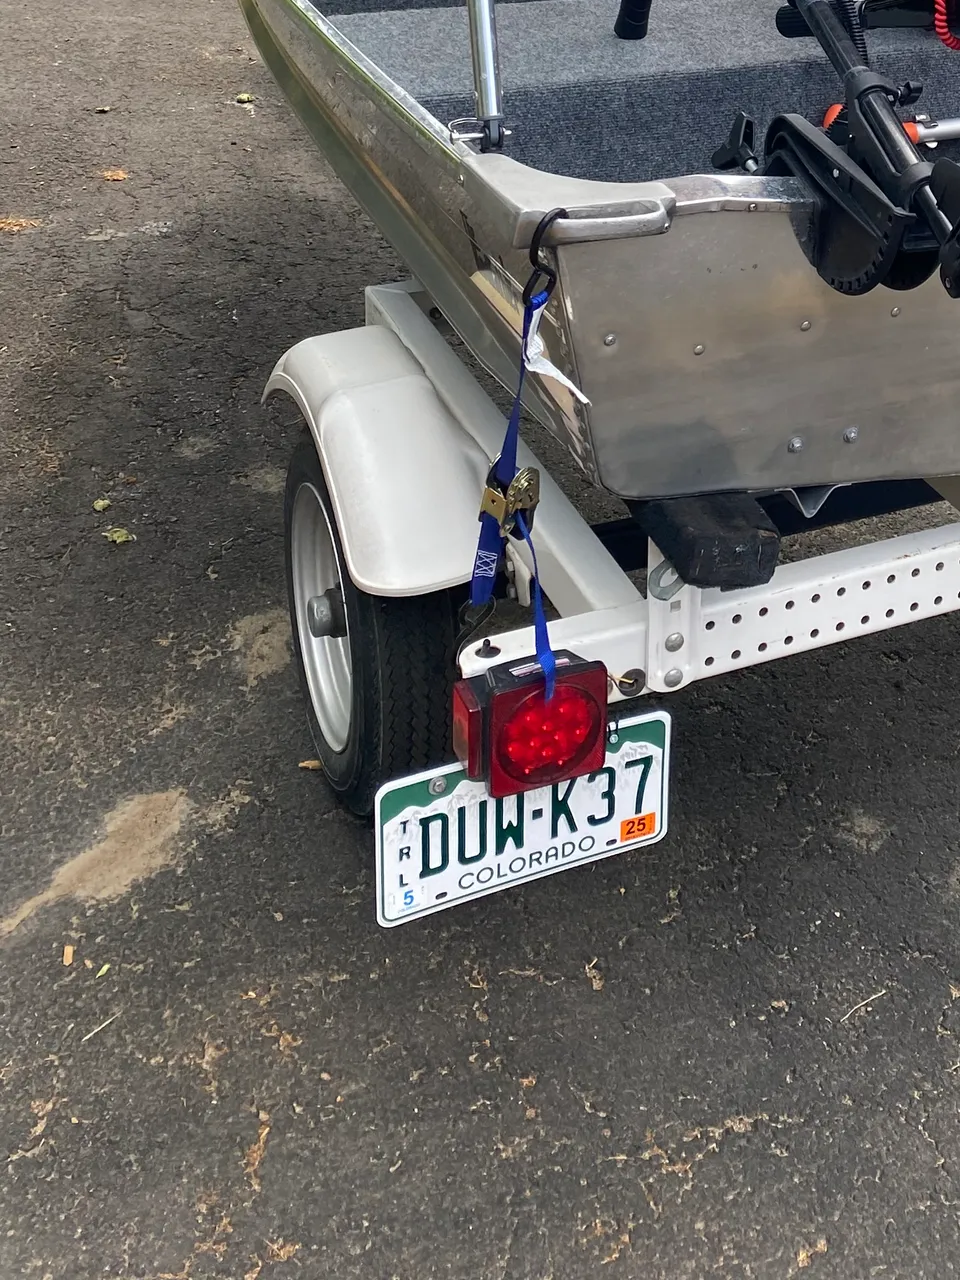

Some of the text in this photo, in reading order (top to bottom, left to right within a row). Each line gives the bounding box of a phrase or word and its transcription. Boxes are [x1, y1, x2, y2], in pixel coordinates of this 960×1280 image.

[419, 755, 654, 880] DUW-K37
[626, 817, 646, 836] 25
[458, 835, 595, 890] COLORADO
[403, 889, 415, 906] 5
